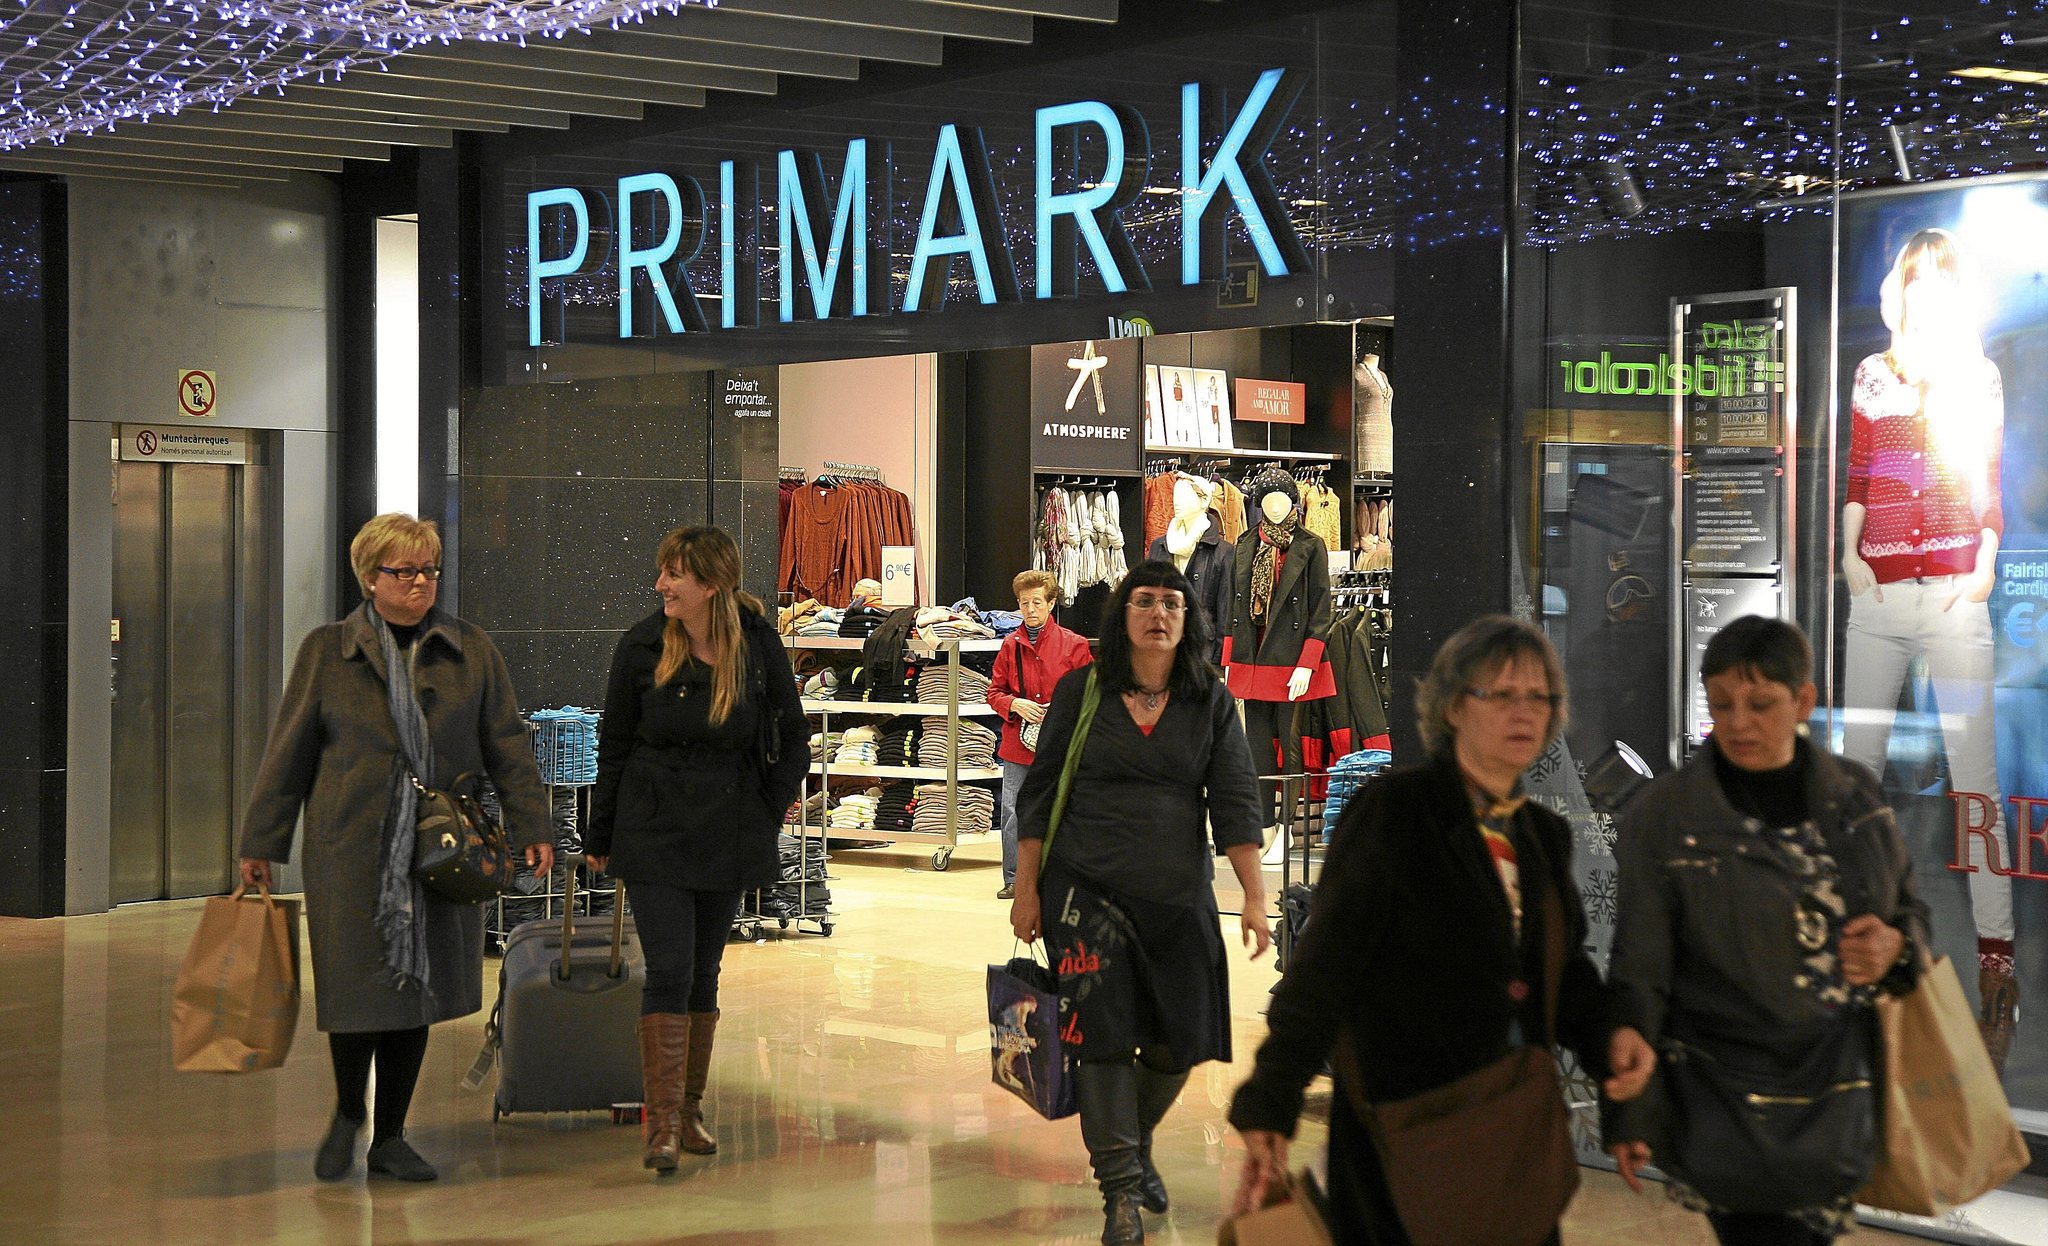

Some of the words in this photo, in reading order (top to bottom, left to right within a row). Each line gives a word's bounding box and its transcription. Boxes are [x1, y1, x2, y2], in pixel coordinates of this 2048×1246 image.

[528, 67, 1290, 347] PRIMARK
[726, 379, 759, 392] Deixa't
[725, 393, 772, 407] emportar...
[1258, 387, 1290, 401] REGALAR
[1263, 401, 1290, 416] AMOR
[161, 433, 229, 446] Muntacàrreques
[160, 447, 180, 455] Només
[181, 448, 205, 456] personal
[1060, 886, 1082, 928] la
[1058, 940, 1101, 976] vida
